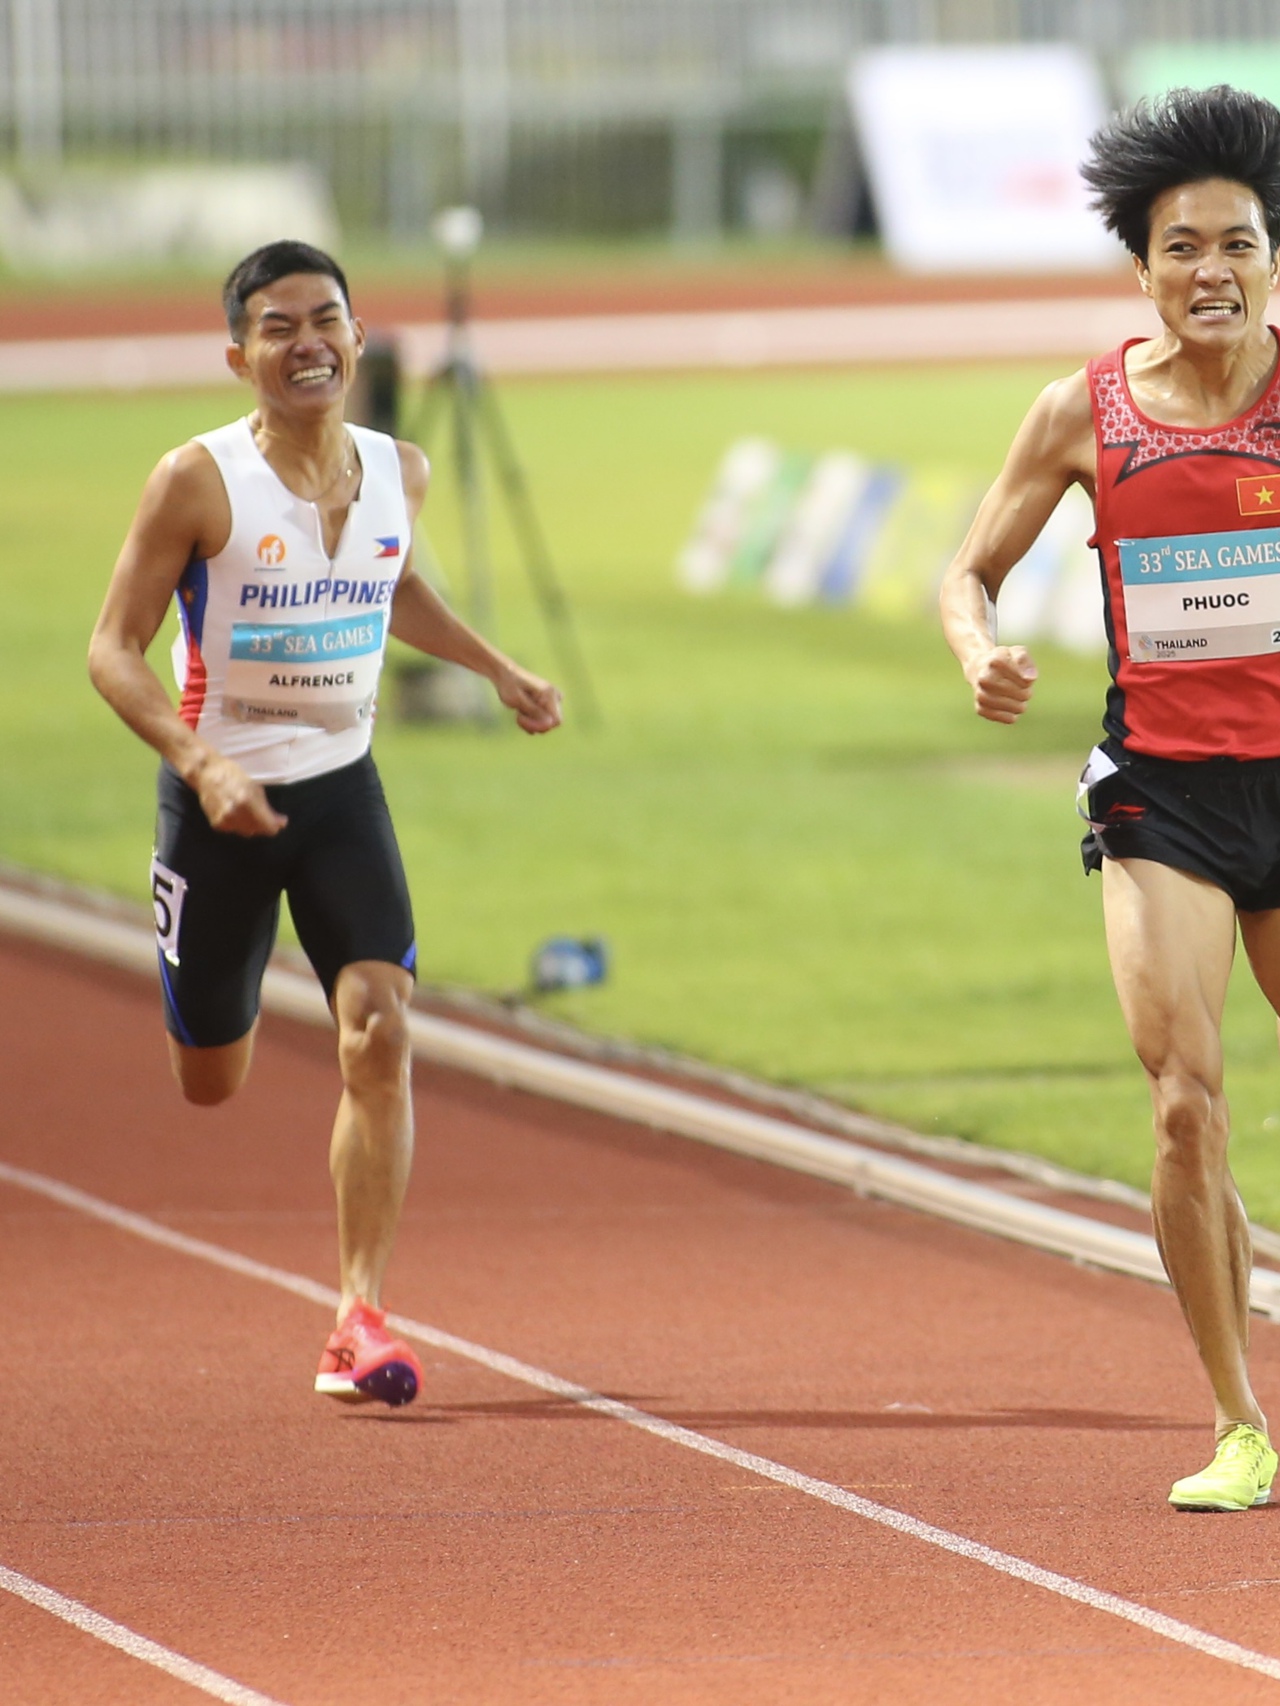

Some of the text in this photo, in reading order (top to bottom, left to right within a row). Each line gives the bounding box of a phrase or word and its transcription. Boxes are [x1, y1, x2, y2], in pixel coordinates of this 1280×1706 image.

[1138, 545, 1171, 574] 33rd
[1175, 549, 1212, 572] SEA
[1182, 592, 1251, 612] PHUOC
[284, 634, 317, 654] SEA
[322, 624, 374, 651] GAMES
[1154, 638, 1208, 650] THAILAND
[269, 671, 355, 687] ALFRENCE
[247, 706, 298, 718] THAILAND
